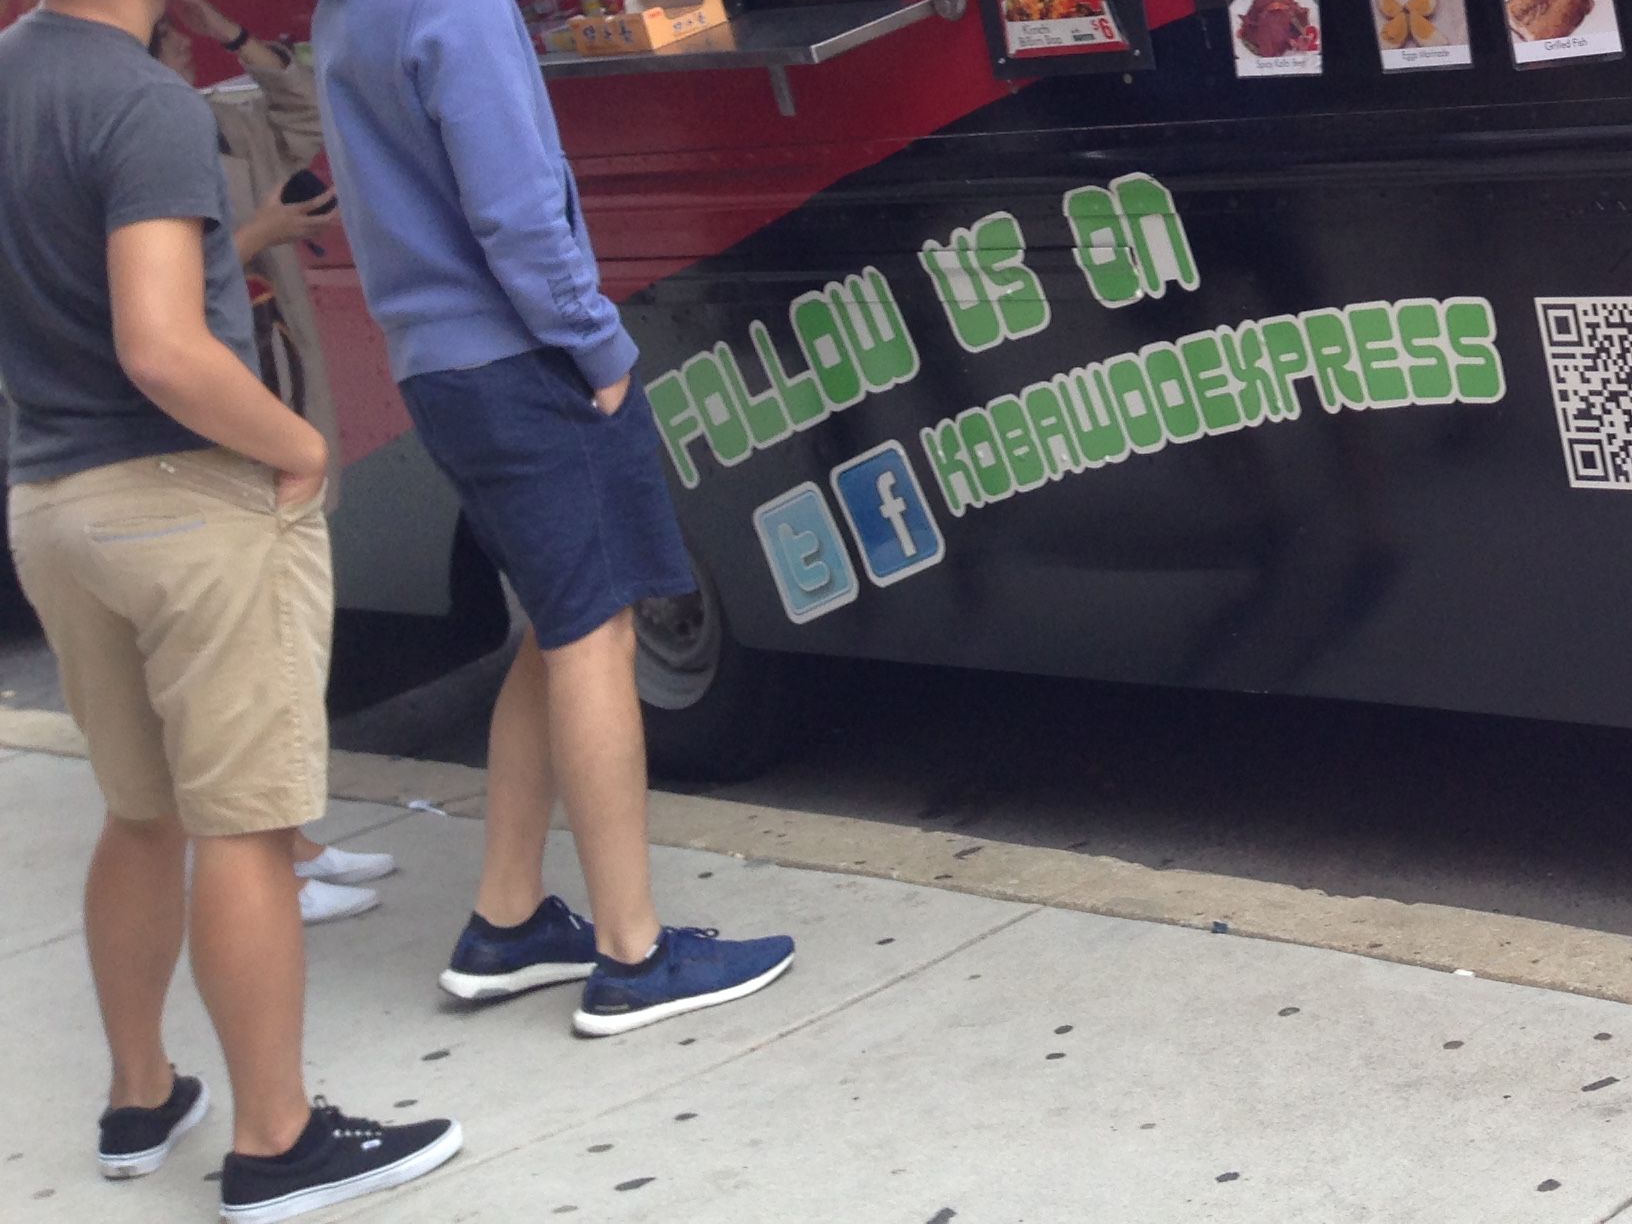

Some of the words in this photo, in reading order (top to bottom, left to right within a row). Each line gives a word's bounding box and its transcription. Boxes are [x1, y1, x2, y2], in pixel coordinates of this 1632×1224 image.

[1544, 40, 1571, 52] Grilled
[1572, 37, 1588, 48] Fish
[641, 265, 921, 489] FOLLOW
[916, 209, 1052, 354] US
[1061, 171, 1203, 310] ON
[919, 295, 1509, 517] KOBAWOOEXPRESS
